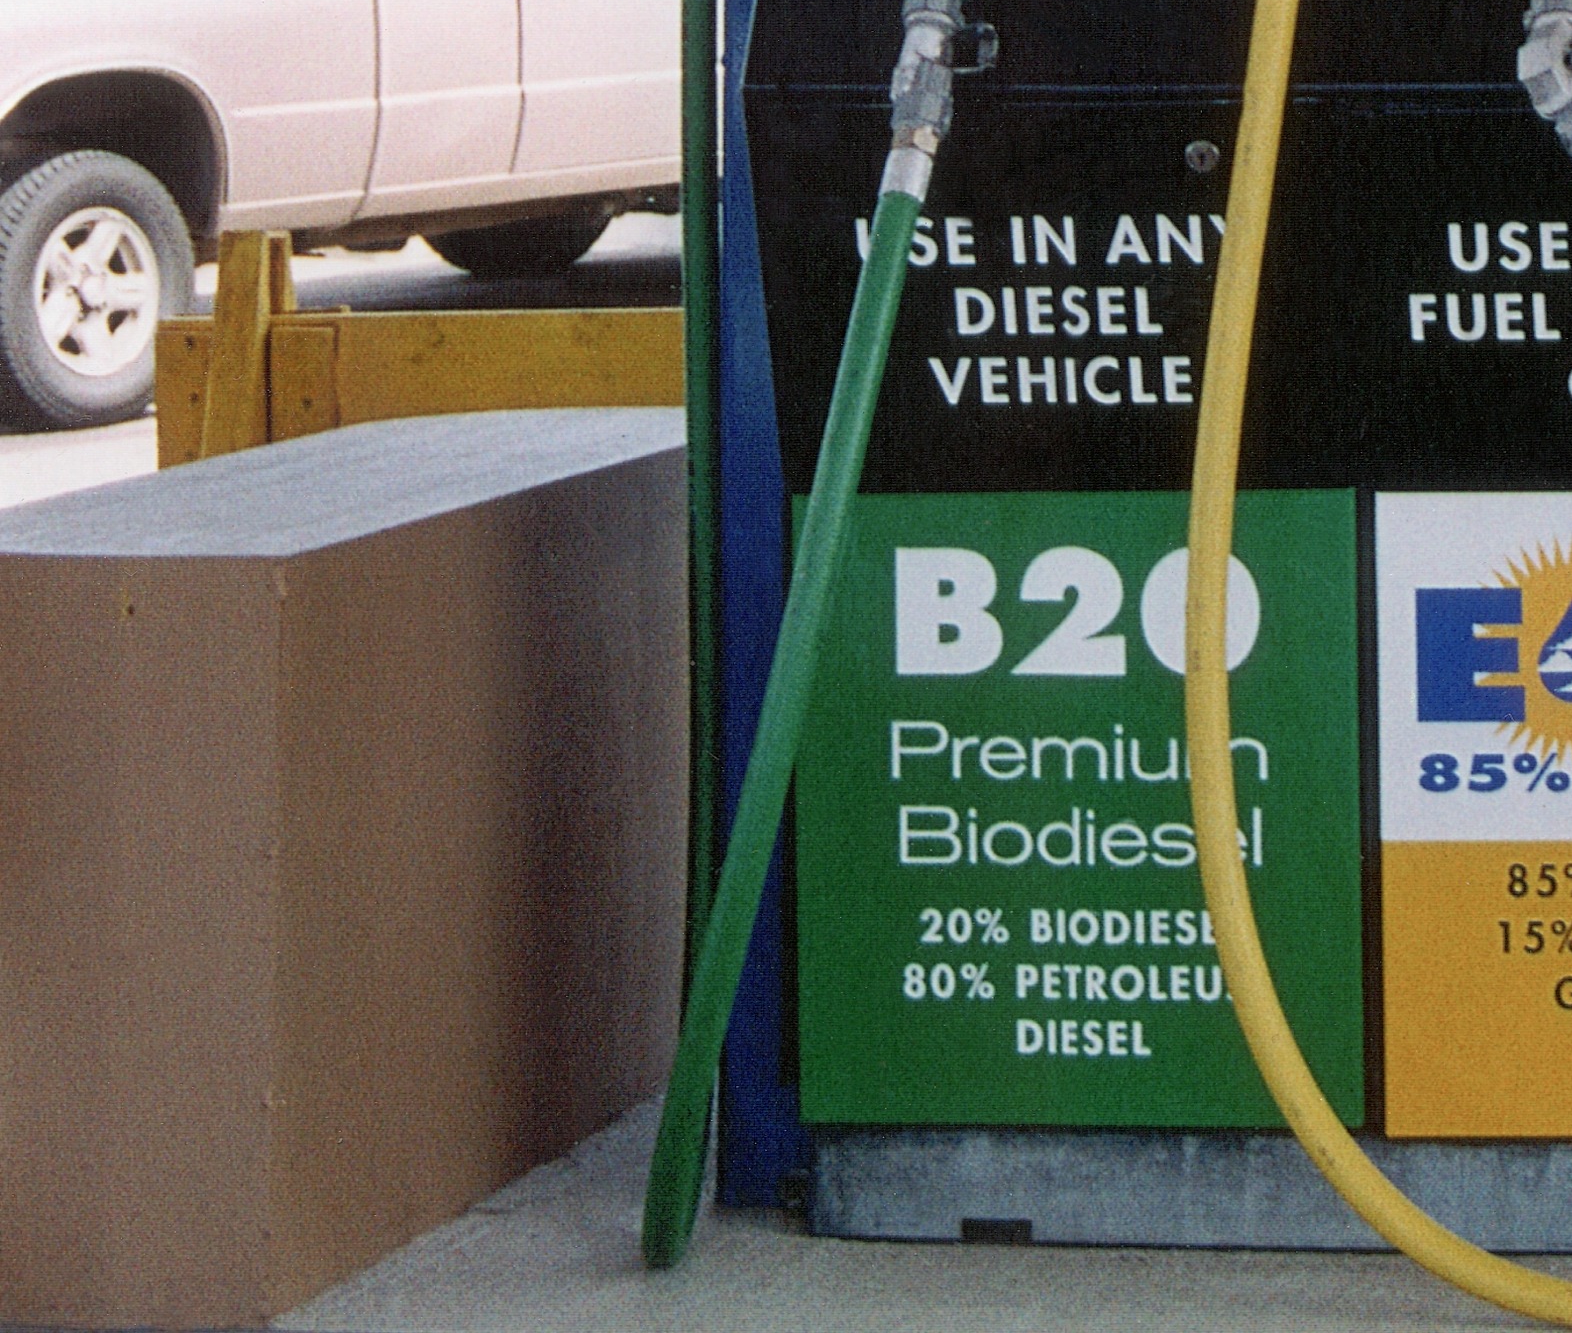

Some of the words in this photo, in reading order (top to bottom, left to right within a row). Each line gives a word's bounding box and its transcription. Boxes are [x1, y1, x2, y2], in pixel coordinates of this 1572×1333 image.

[1010, 215, 1078, 265] IN
[1106, 214, 1228, 265] AN
[1447, 222, 1570, 271] USE
[954, 286, 1163, 336] DIESEL
[1408, 293, 1561, 341] FUEL
[928, 356, 1193, 405] VEHICLE
[894, 546, 1261, 676] B20
[1419, 752, 1570, 793] 85%
[898, 804, 1263, 867] Biodiesl
[919, 908, 1010, 945] 20%
[1030, 909, 1217, 945] BIODIESE
[903, 962, 995, 1000] 80%
[1016, 964, 1234, 1001] PETROLEU
[1016, 1020, 1152, 1056] DIESEL
